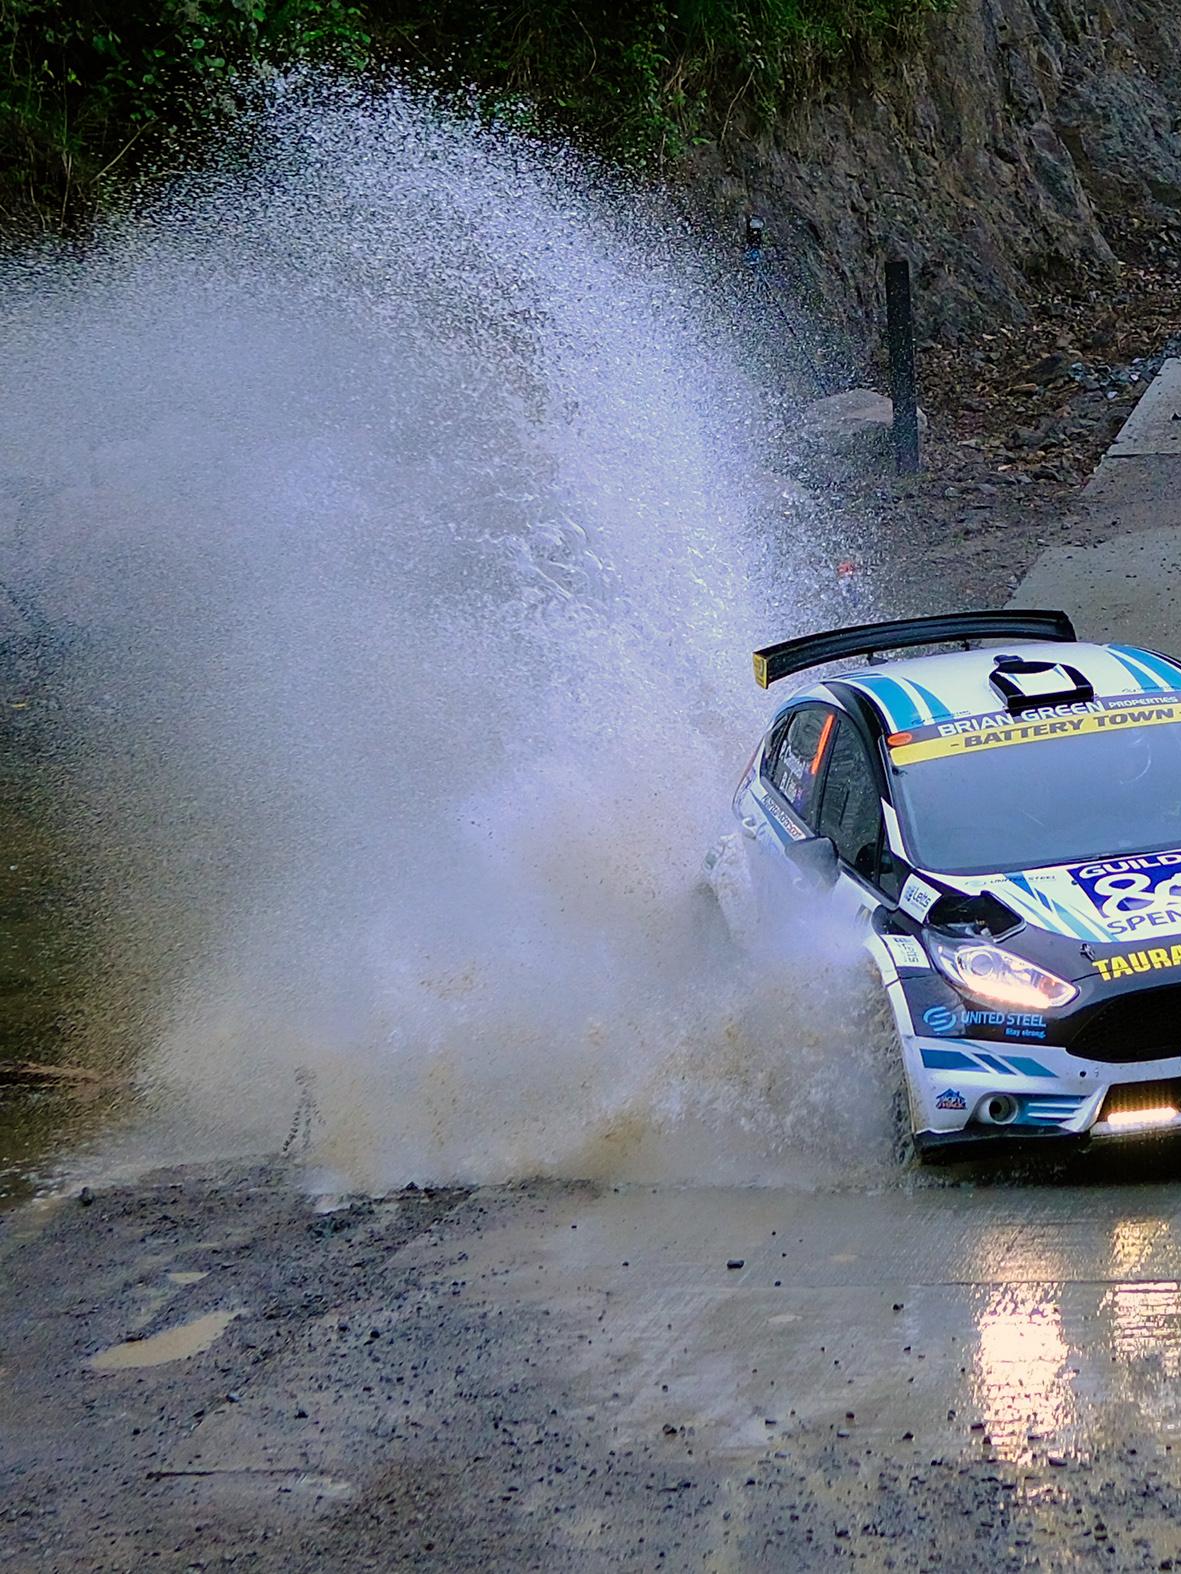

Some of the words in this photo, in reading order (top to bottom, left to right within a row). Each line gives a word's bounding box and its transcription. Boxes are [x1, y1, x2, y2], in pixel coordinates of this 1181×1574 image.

[938, 711, 1014, 737] BRIAN
[1021, 700, 1105, 723] GREEN
[1108, 696, 1179, 709] PROPERTIES
[963, 717, 1086, 748] BATTERY
[1097, 708, 1175, 727] TOWN
[961, 1010, 1005, 1025] UNITED
[1006, 1013, 1047, 1028] STEEL
